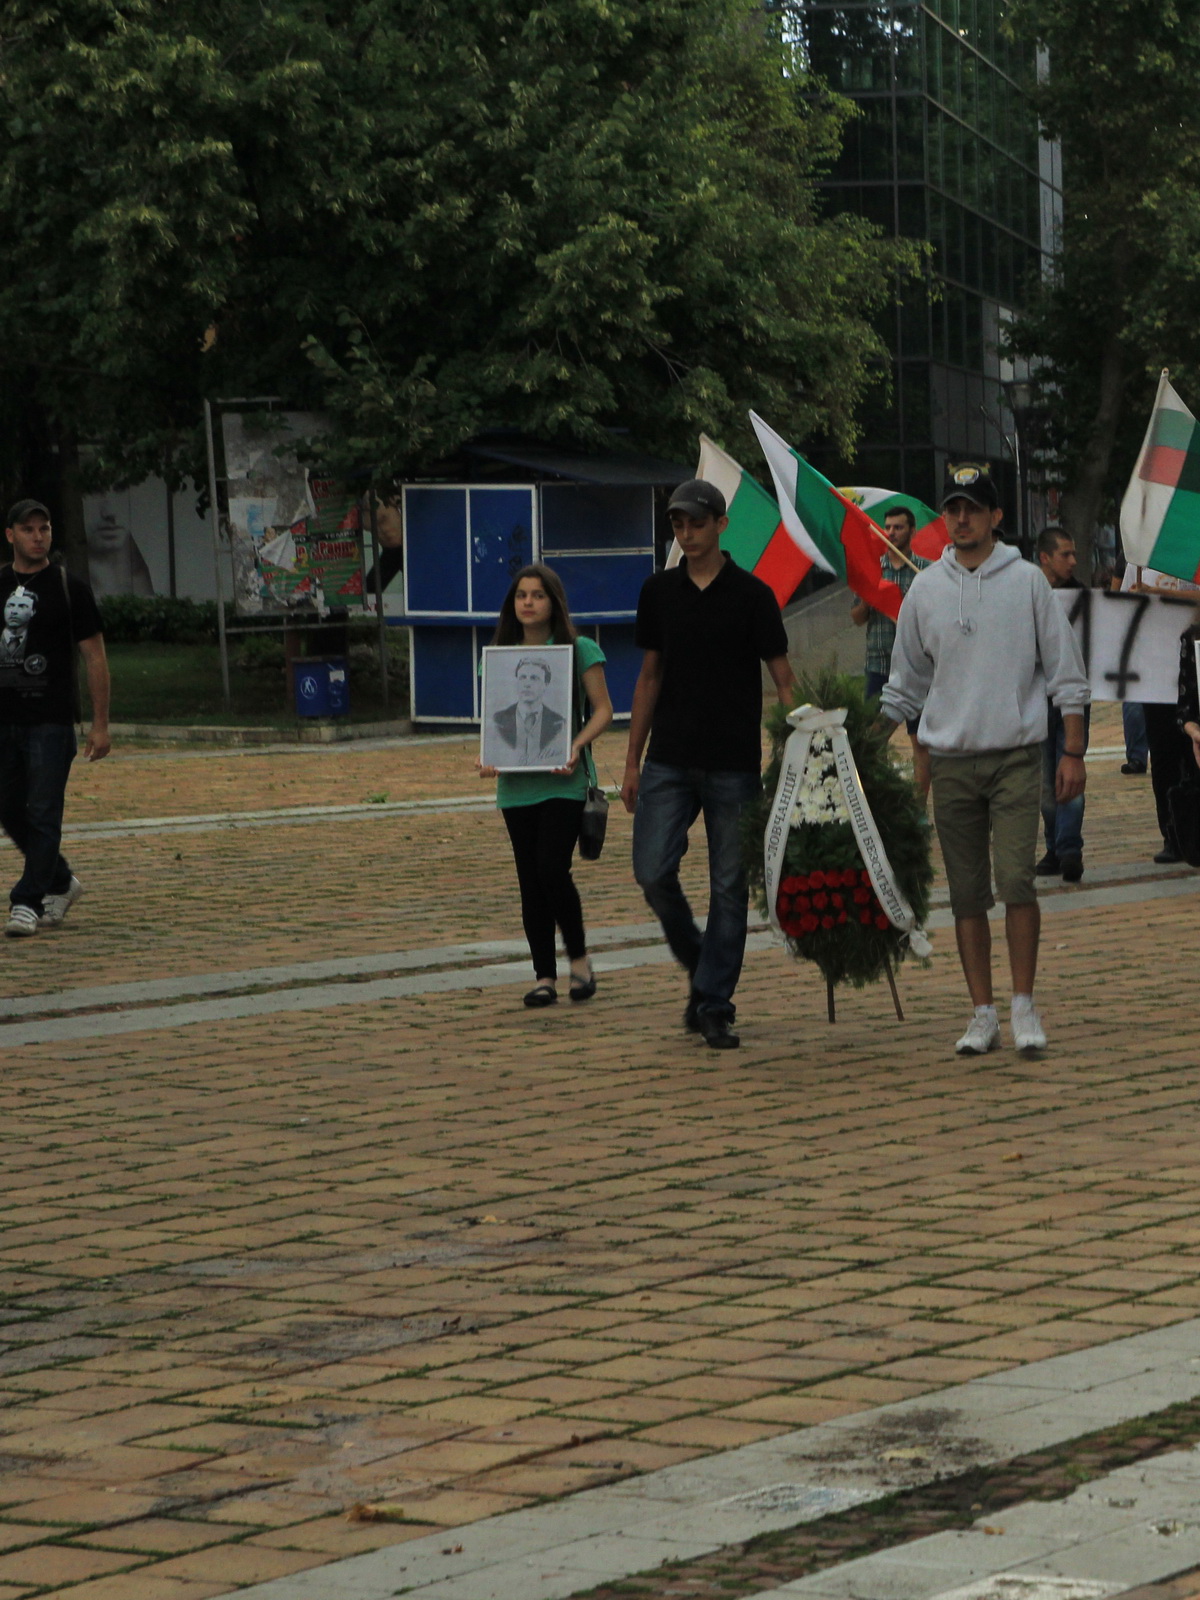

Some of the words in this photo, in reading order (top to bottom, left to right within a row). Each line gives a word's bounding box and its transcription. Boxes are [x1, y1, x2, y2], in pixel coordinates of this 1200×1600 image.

[1067, 589, 1198, 699] 17
[837, 751, 850, 772] 177
[844, 776, 869, 833] ГОДИНИ
[863, 836, 906, 923] БЕЗСМЪРТИЕ
